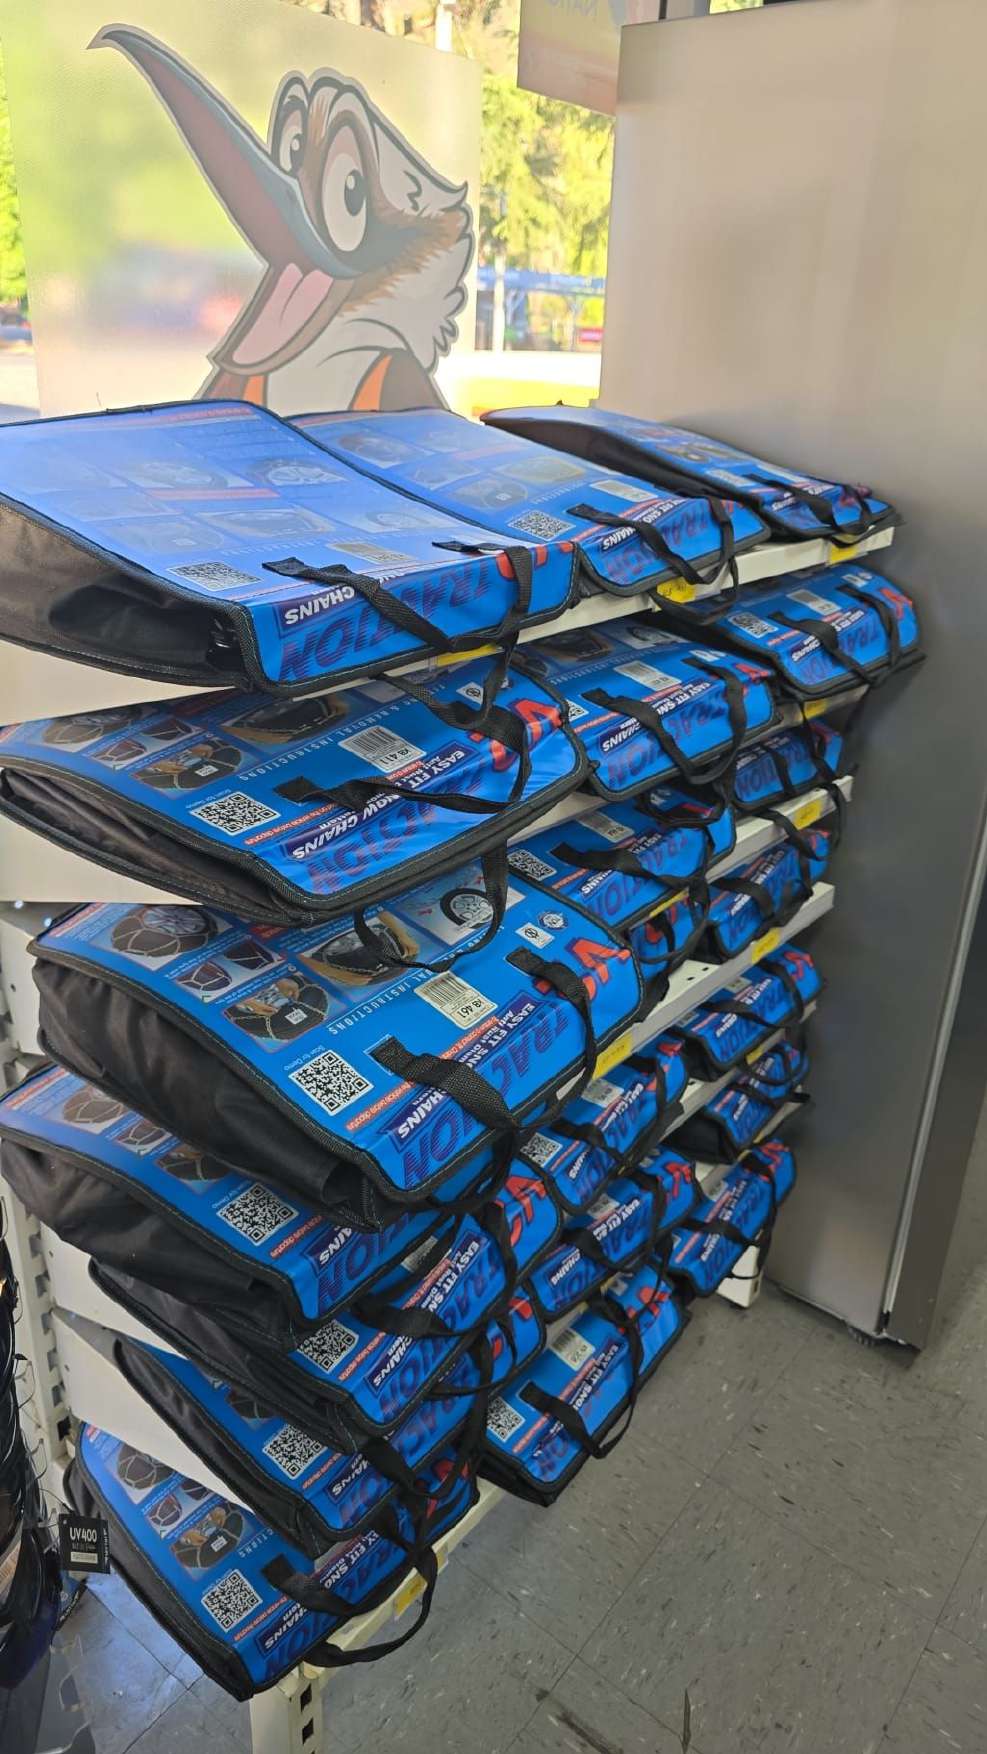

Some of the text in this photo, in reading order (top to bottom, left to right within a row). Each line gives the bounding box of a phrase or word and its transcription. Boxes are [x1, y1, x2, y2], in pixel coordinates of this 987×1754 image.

[642, 509, 663, 525] SNO
[602, 526, 637, 550] HAINS
[284, 586, 355, 625] CHAINS
[436, 750, 465, 771] EASY
[410, 769, 436, 790] FIT
[363, 794, 401, 818] NOW
[319, 811, 355, 829] attern
[292, 813, 358, 859] CHAINS
[329, 983, 411, 1035] INSTRUCTIONS
[459, 1004, 475, 1019] 461
[498, 1009, 513, 1026] Anti
[508, 1003, 536, 1029] EASY
[483, 1025, 500, 1041] Rust
[491, 1028, 507, 1048] FIT
[459, 1039, 483, 1063] Diam
[467, 1048, 489, 1068] SN
[403, 1008, 569, 1188] TRACION
[398, 1087, 447, 1139] HAINS
[319, 1228, 352, 1265] AINS
[454, 1239, 480, 1272] EASY
[441, 1272, 459, 1292] FIT
[426, 1291, 445, 1313] SN
[570, 1383, 593, 1410] SNO
[70, 1527, 97, 1542] UV400
[324, 1562, 350, 1589] SNO
[265, 1605, 307, 1648] HAINS
